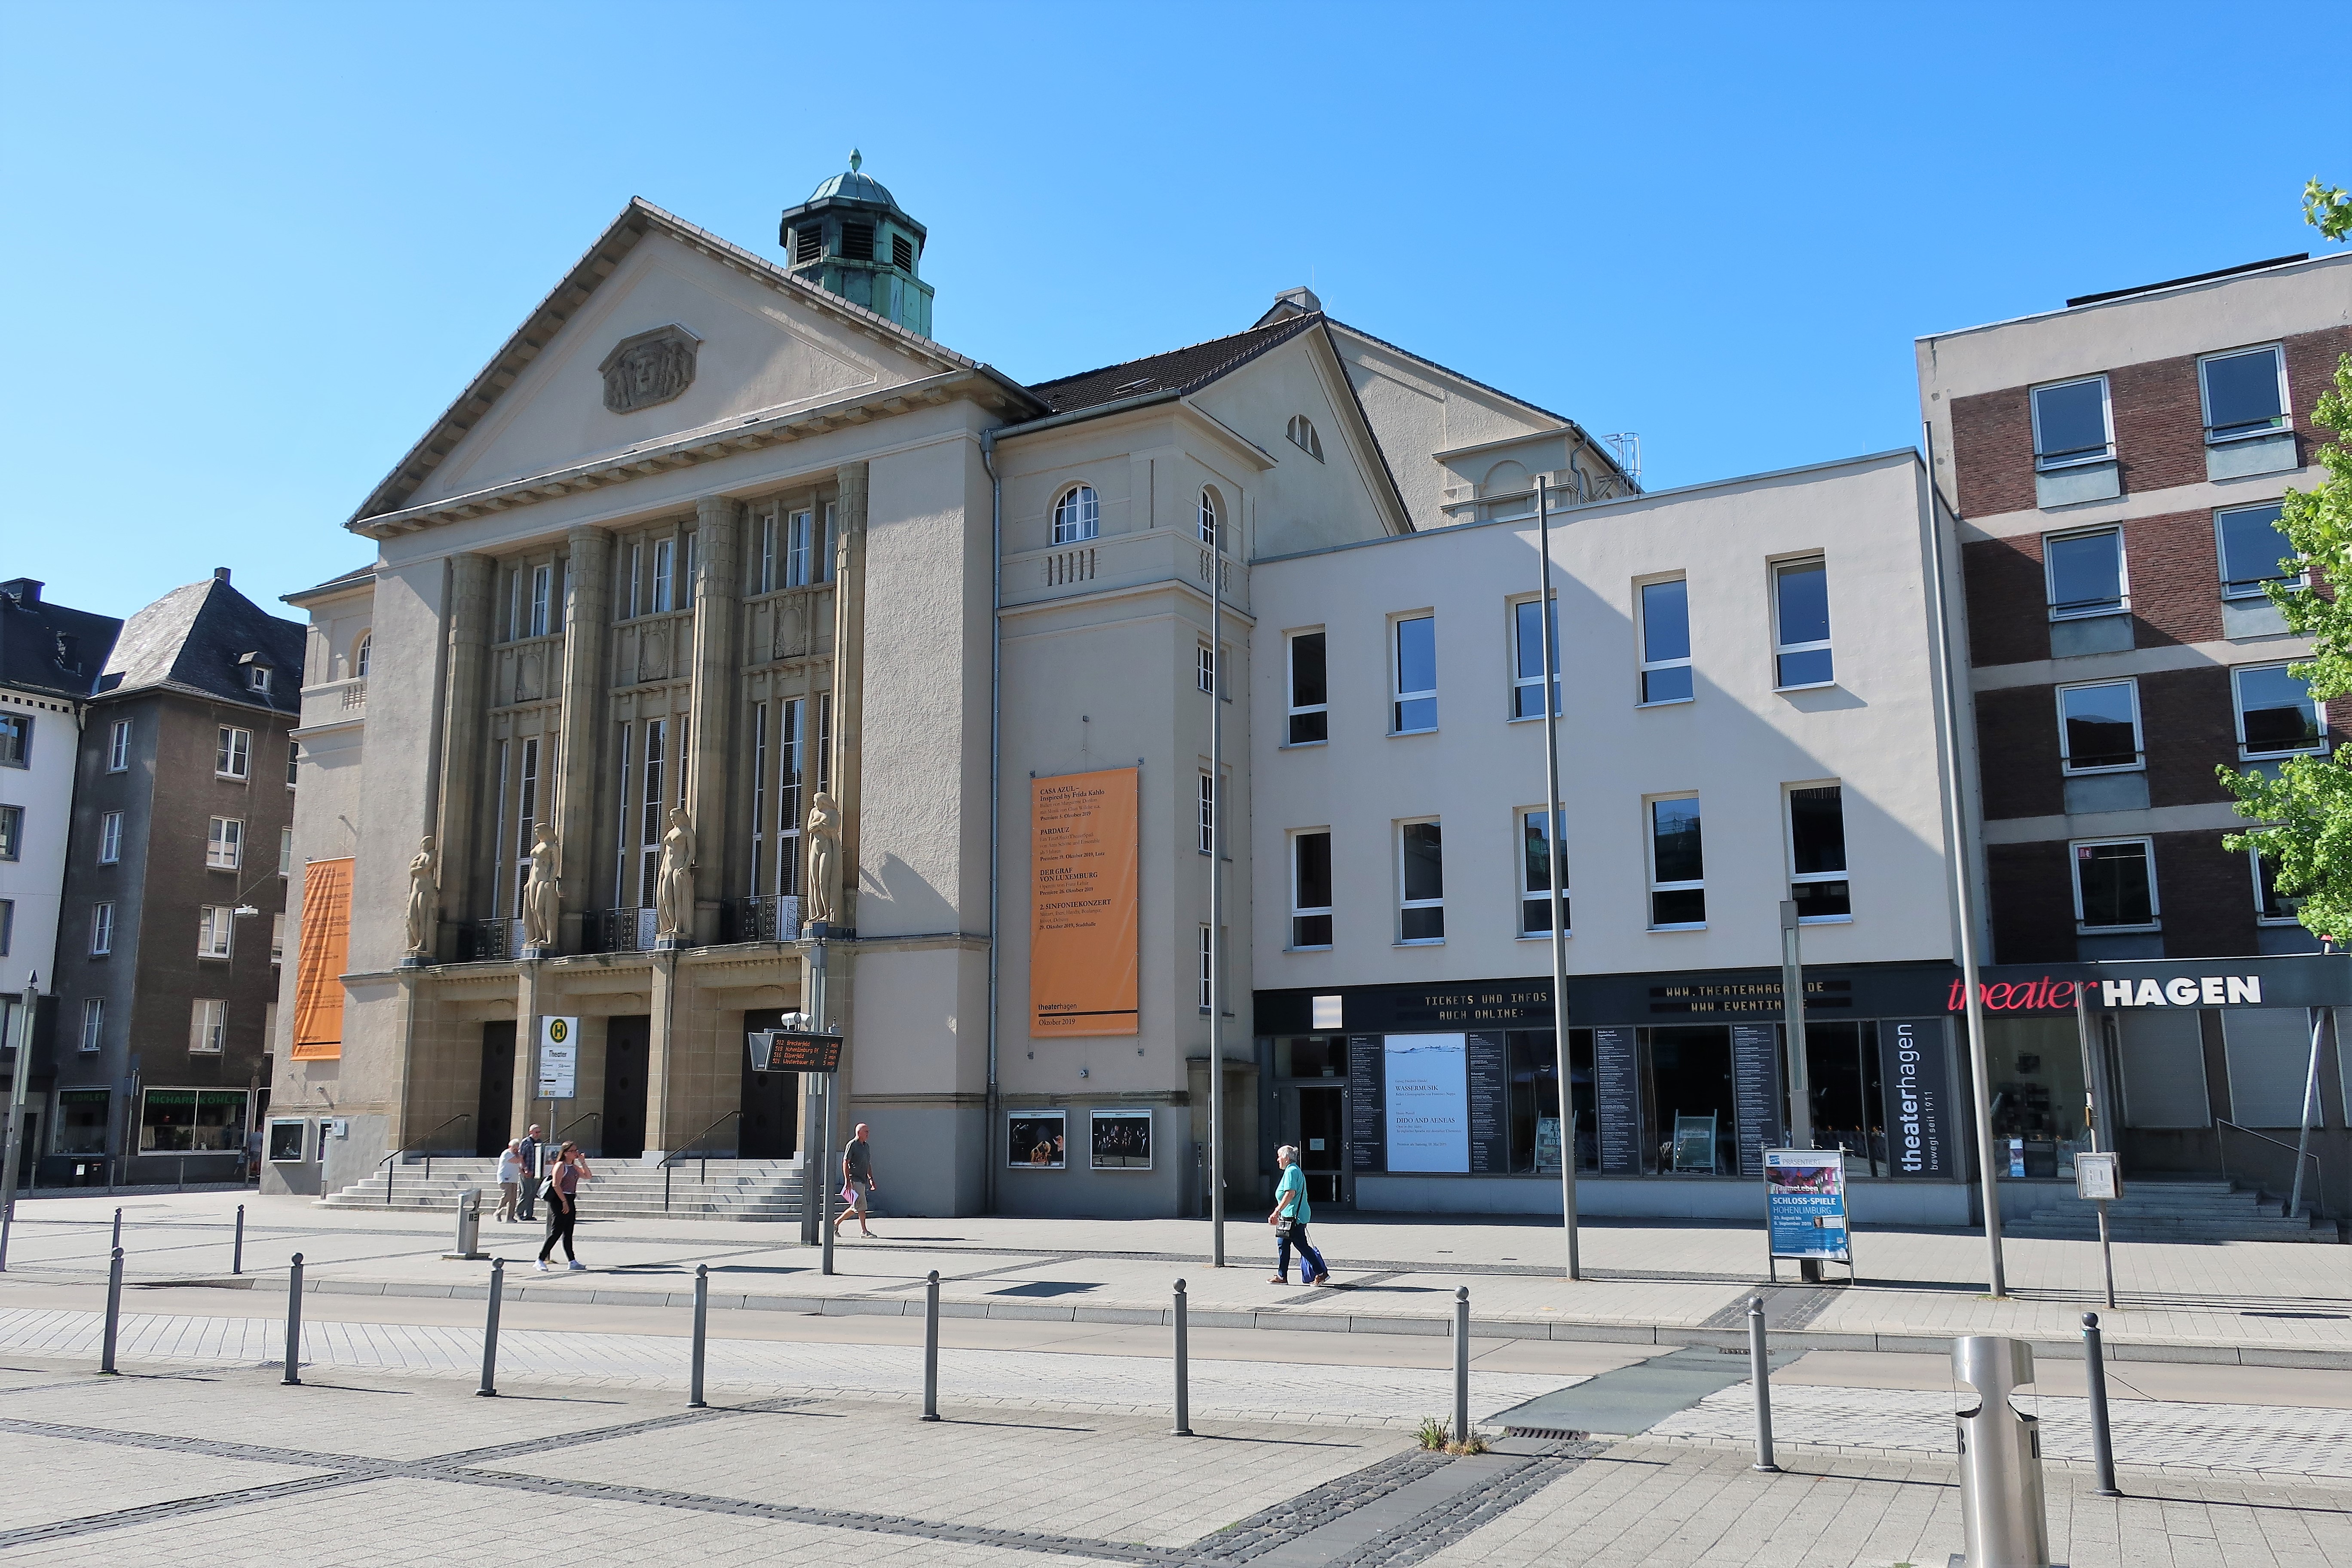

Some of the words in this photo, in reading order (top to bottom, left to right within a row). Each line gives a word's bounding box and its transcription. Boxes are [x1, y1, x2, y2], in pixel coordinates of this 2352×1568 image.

[1040, 794, 1063, 802] Inspired
[1040, 827, 1070, 835] PARDAUZ
[1056, 872, 1098, 881] LUXEMBURG
[1045, 899, 1112, 910] SINFONIEKONZERT
[1666, 982, 1824, 997] WWW.THEATERHAG.DE
[2102, 976, 2262, 1007] HAGEN
[1425, 995, 1473, 1006] TICKETS
[1482, 994, 1503, 1004] UND
[1511, 992, 1547, 1003] INFOS
[1440, 1011, 1467, 1020] AUCH
[1475, 1008, 1524, 1019] ONLINE:
[1896, 1023, 1922, 1173] theaterhagen
[1924, 1091, 1934, 1112] 1911
[1926, 1116, 1936, 1133] seit
[1930, 1137, 1939, 1170] bewegt
[1773, 1197, 1836, 1205] SCHLOSS-SPIELE
[1773, 1206, 1832, 1214] HOHENLIMBURG
